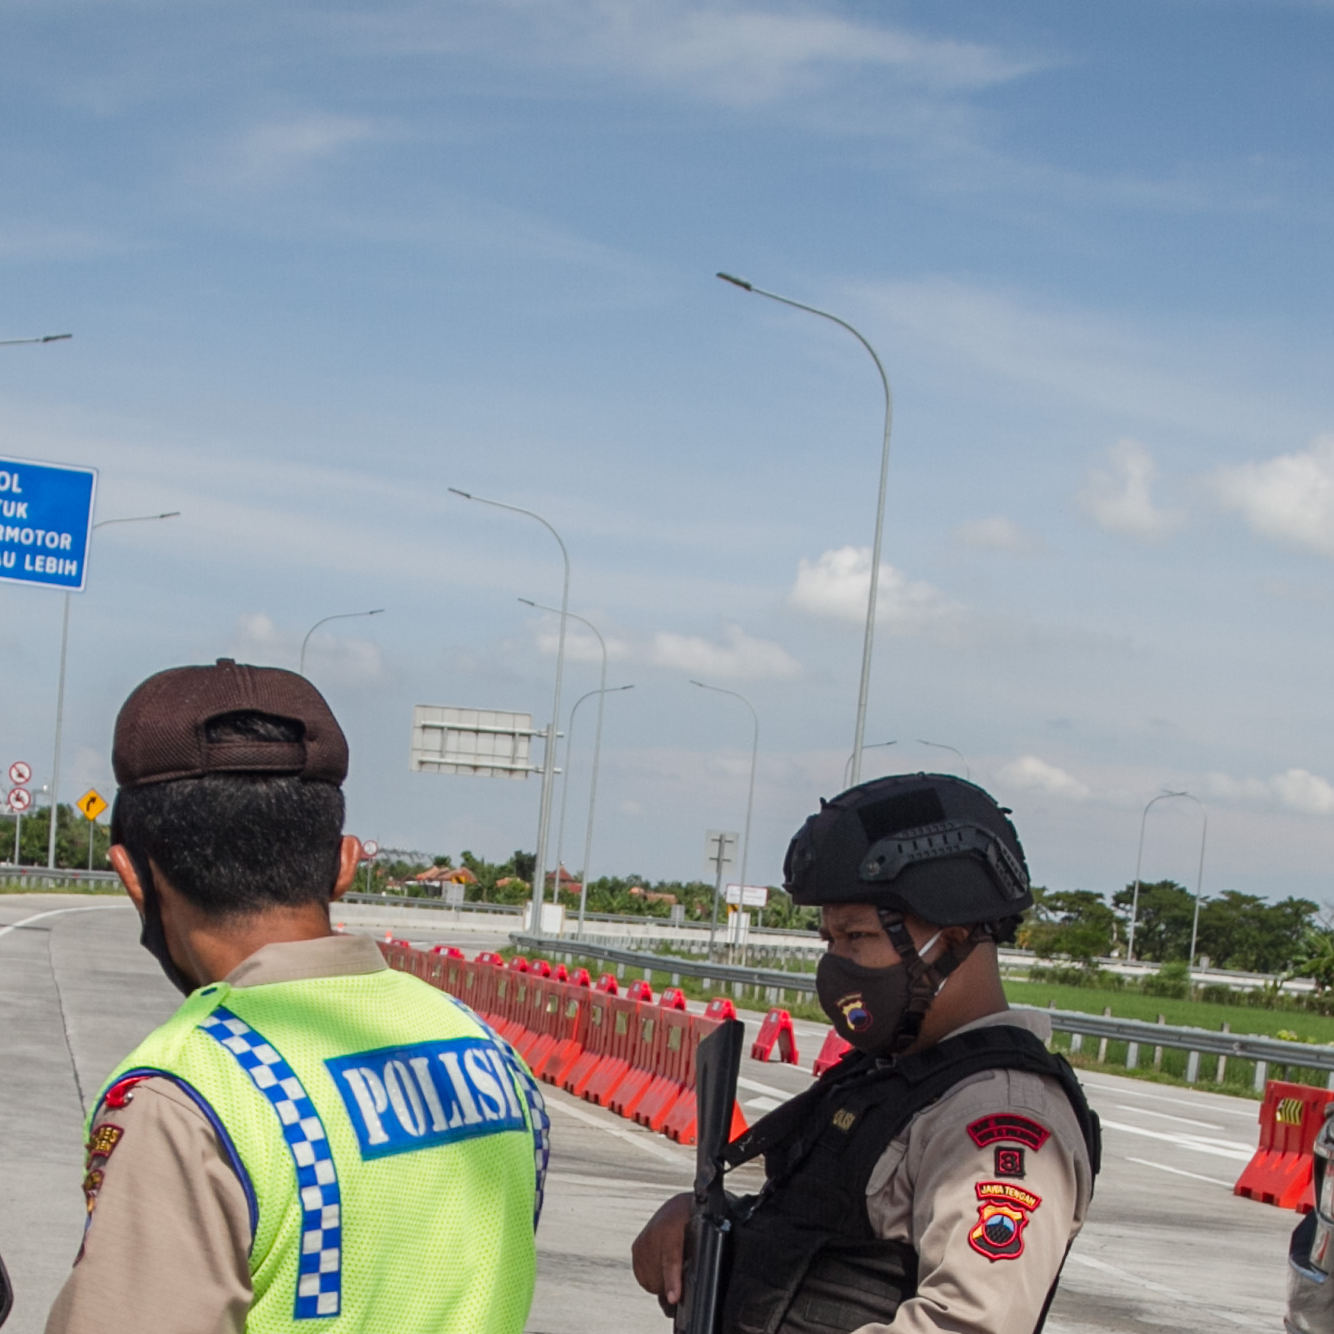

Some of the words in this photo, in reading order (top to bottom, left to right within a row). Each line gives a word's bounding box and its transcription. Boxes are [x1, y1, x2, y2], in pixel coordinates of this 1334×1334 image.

[24, 554, 78, 577] LEBIH
[342, 1048, 522, 1145] POLISI
[981, 1185, 1004, 1194] JAWA
[1004, 1186, 1036, 1206] TENGAH
